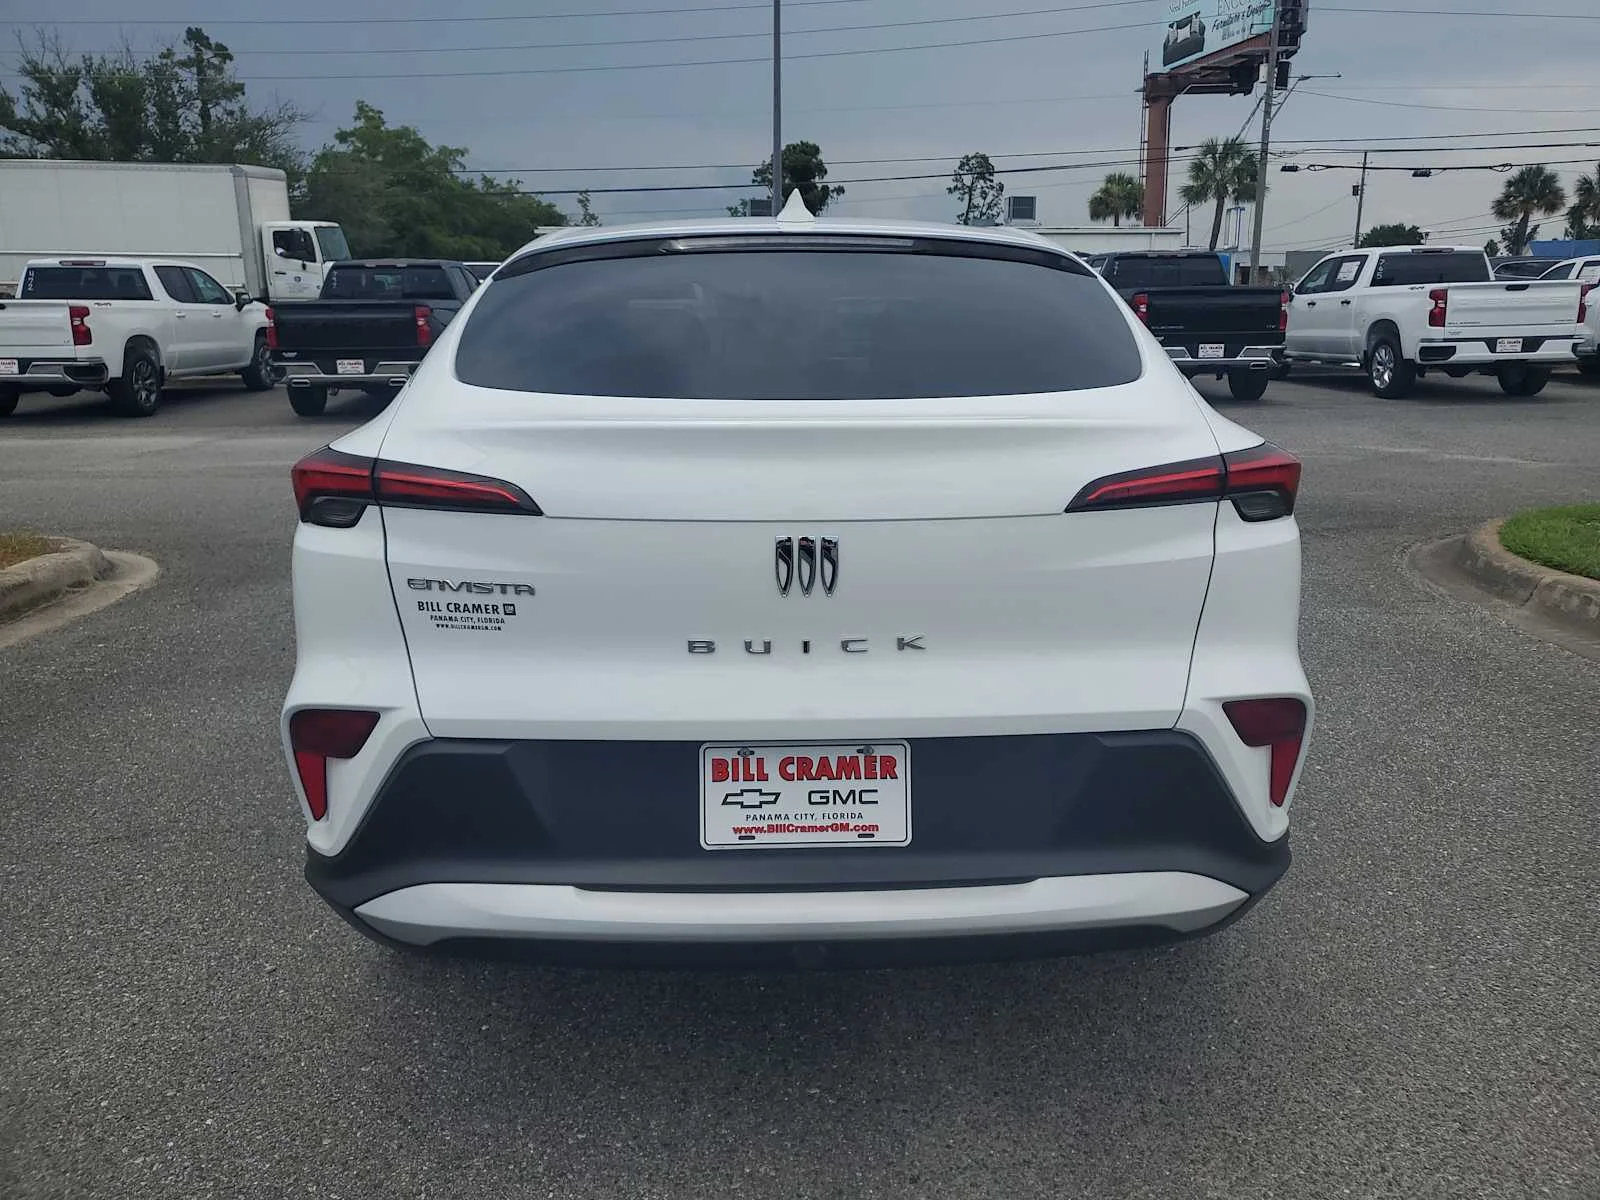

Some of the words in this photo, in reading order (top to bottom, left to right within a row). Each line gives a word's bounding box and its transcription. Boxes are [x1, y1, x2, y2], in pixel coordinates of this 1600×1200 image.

[407, 578, 536, 596] ENVISTA
[417, 601, 442, 612] BILL
[446, 602, 500, 615] CRAMER
[430, 614, 459, 623] PANAMA
[460, 616, 476, 625] CITY,
[687, 636, 927, 654] BUICK
[711, 757, 769, 782] BILL
[778, 755, 899, 782] CRAMER
[807, 789, 879, 805] GMC
[745, 813, 790, 822] PANAMA
[794, 812, 818, 821] CITY,
[822, 812, 864, 820] FLORIDA
[732, 823, 880, 835] www.BillCramerGM.com
